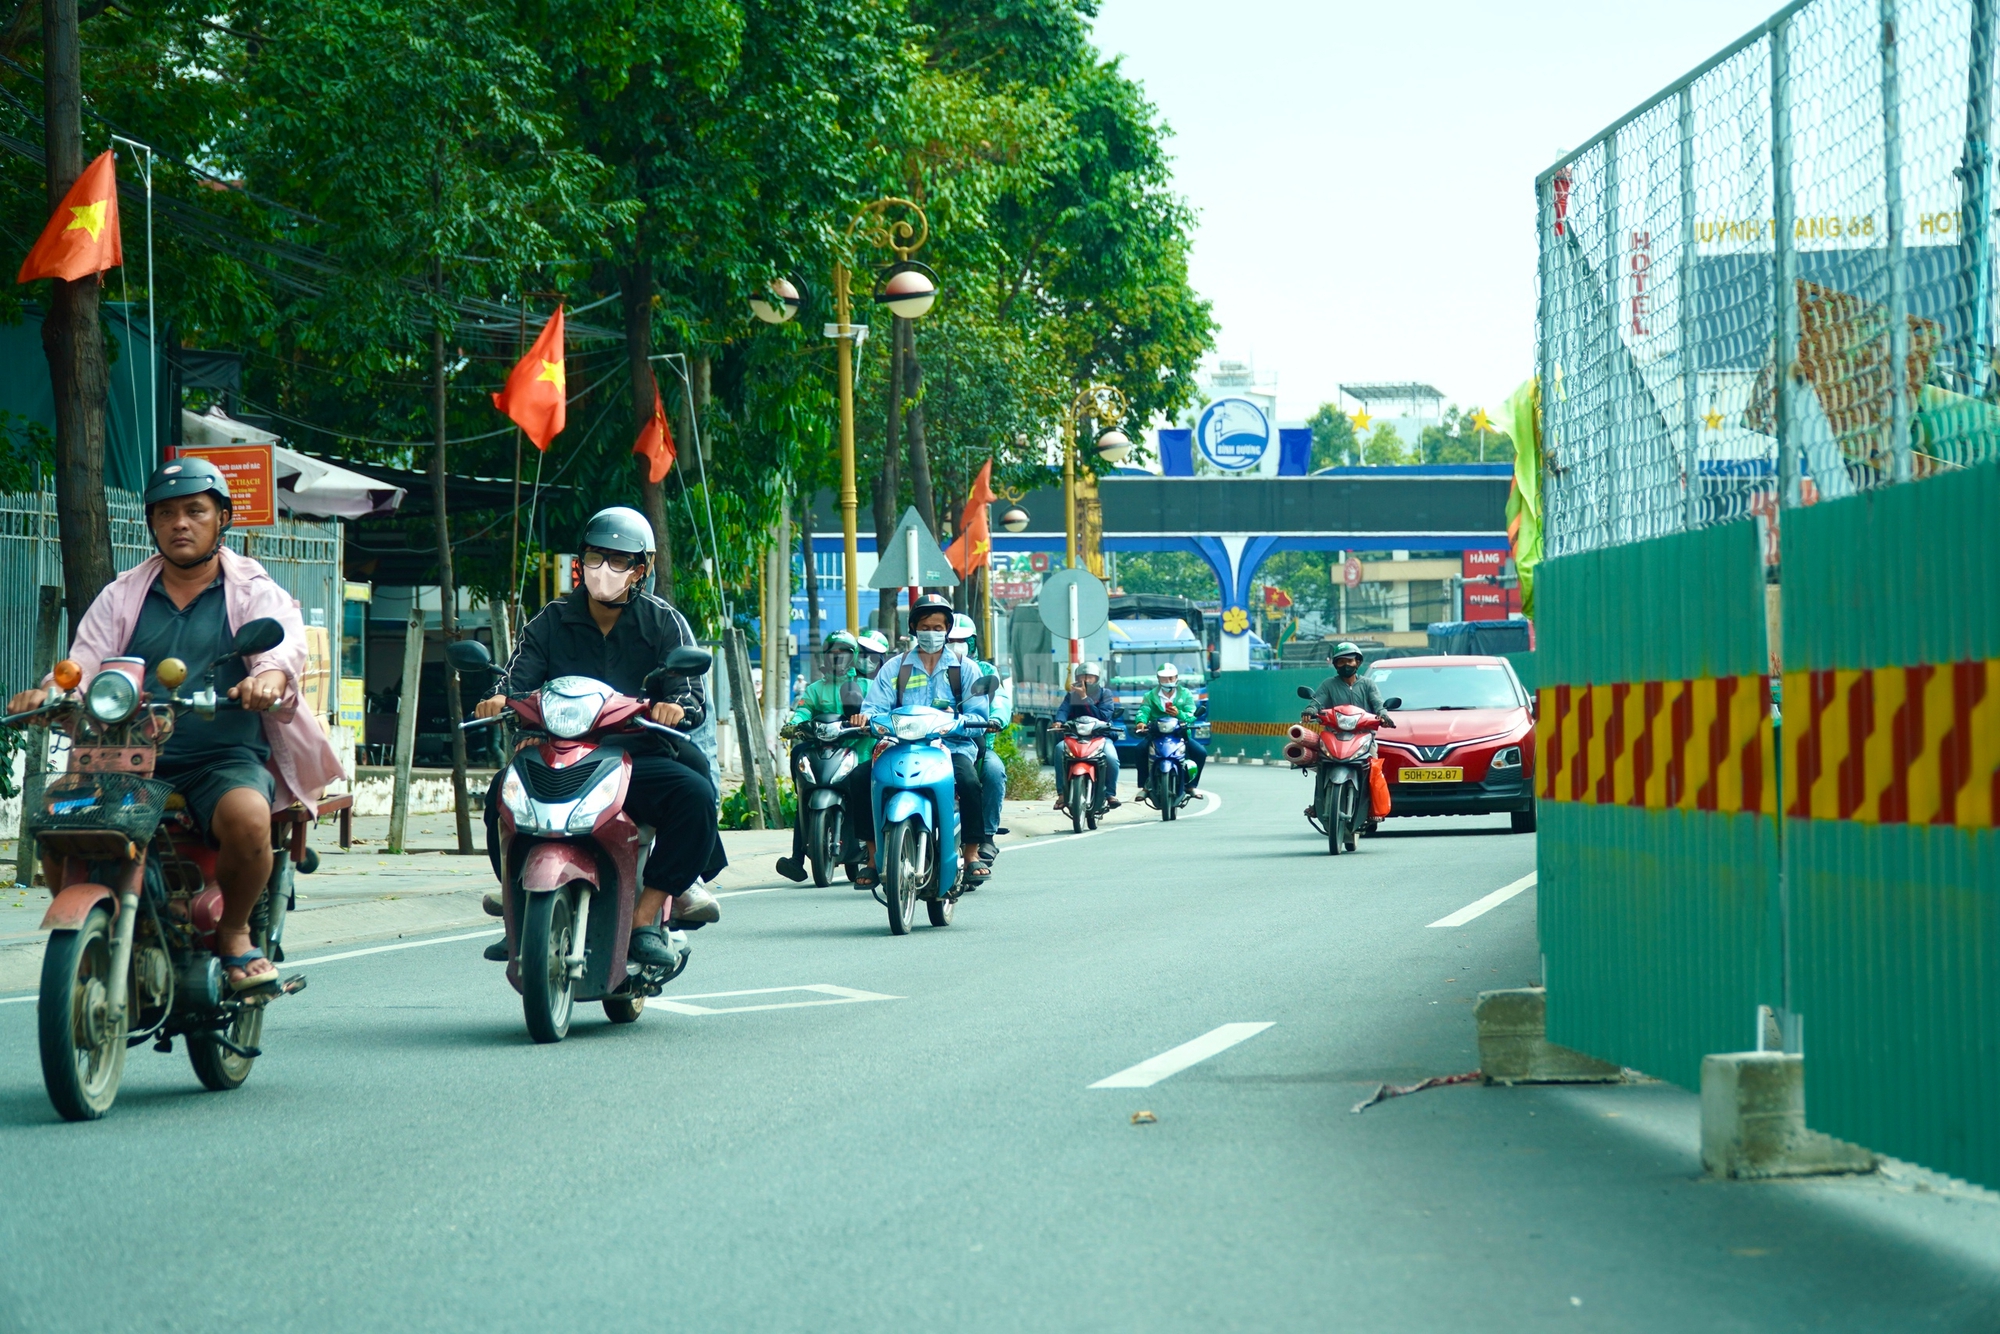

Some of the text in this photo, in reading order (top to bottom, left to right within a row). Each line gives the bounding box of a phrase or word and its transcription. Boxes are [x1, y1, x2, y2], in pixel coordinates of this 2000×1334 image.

[1767, 217, 1842, 240] TANG
[1848, 216, 1875, 237] 68
[1631, 231, 1651, 336] HOTEL
[236, 477, 261, 487] THẠCH
[1470, 550, 1500, 564] HÀNG
[1403, 769, 1457, 780] 50H-792.87
